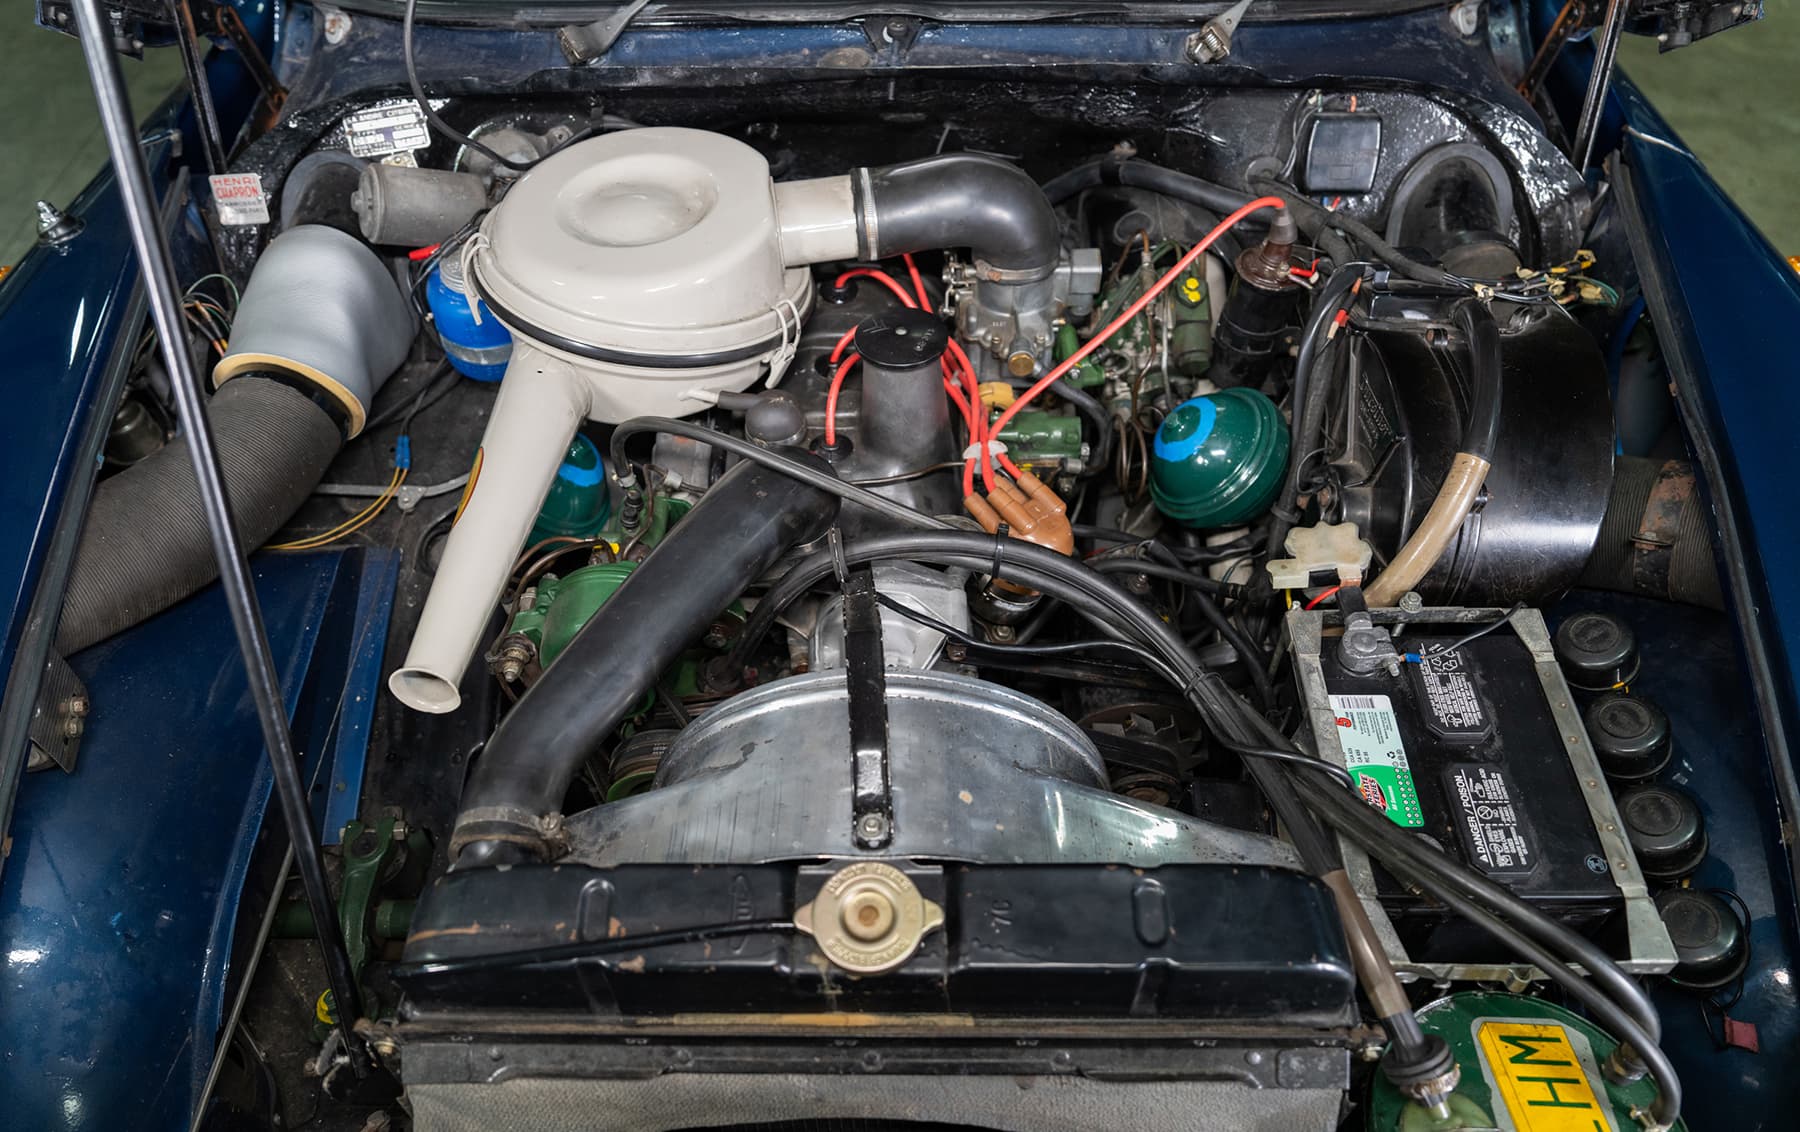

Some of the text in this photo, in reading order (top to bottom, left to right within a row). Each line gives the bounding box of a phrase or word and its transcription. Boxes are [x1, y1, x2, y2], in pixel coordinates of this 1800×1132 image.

[212, 176, 256, 186] HENRI
[215, 186, 259, 199] CHAPRON
[1335, 716, 1352, 728] 5
[1454, 776, 1473, 808] POISON
[1467, 815, 1486, 854] DANGER
[1499, 1035, 1606, 1132] HM
